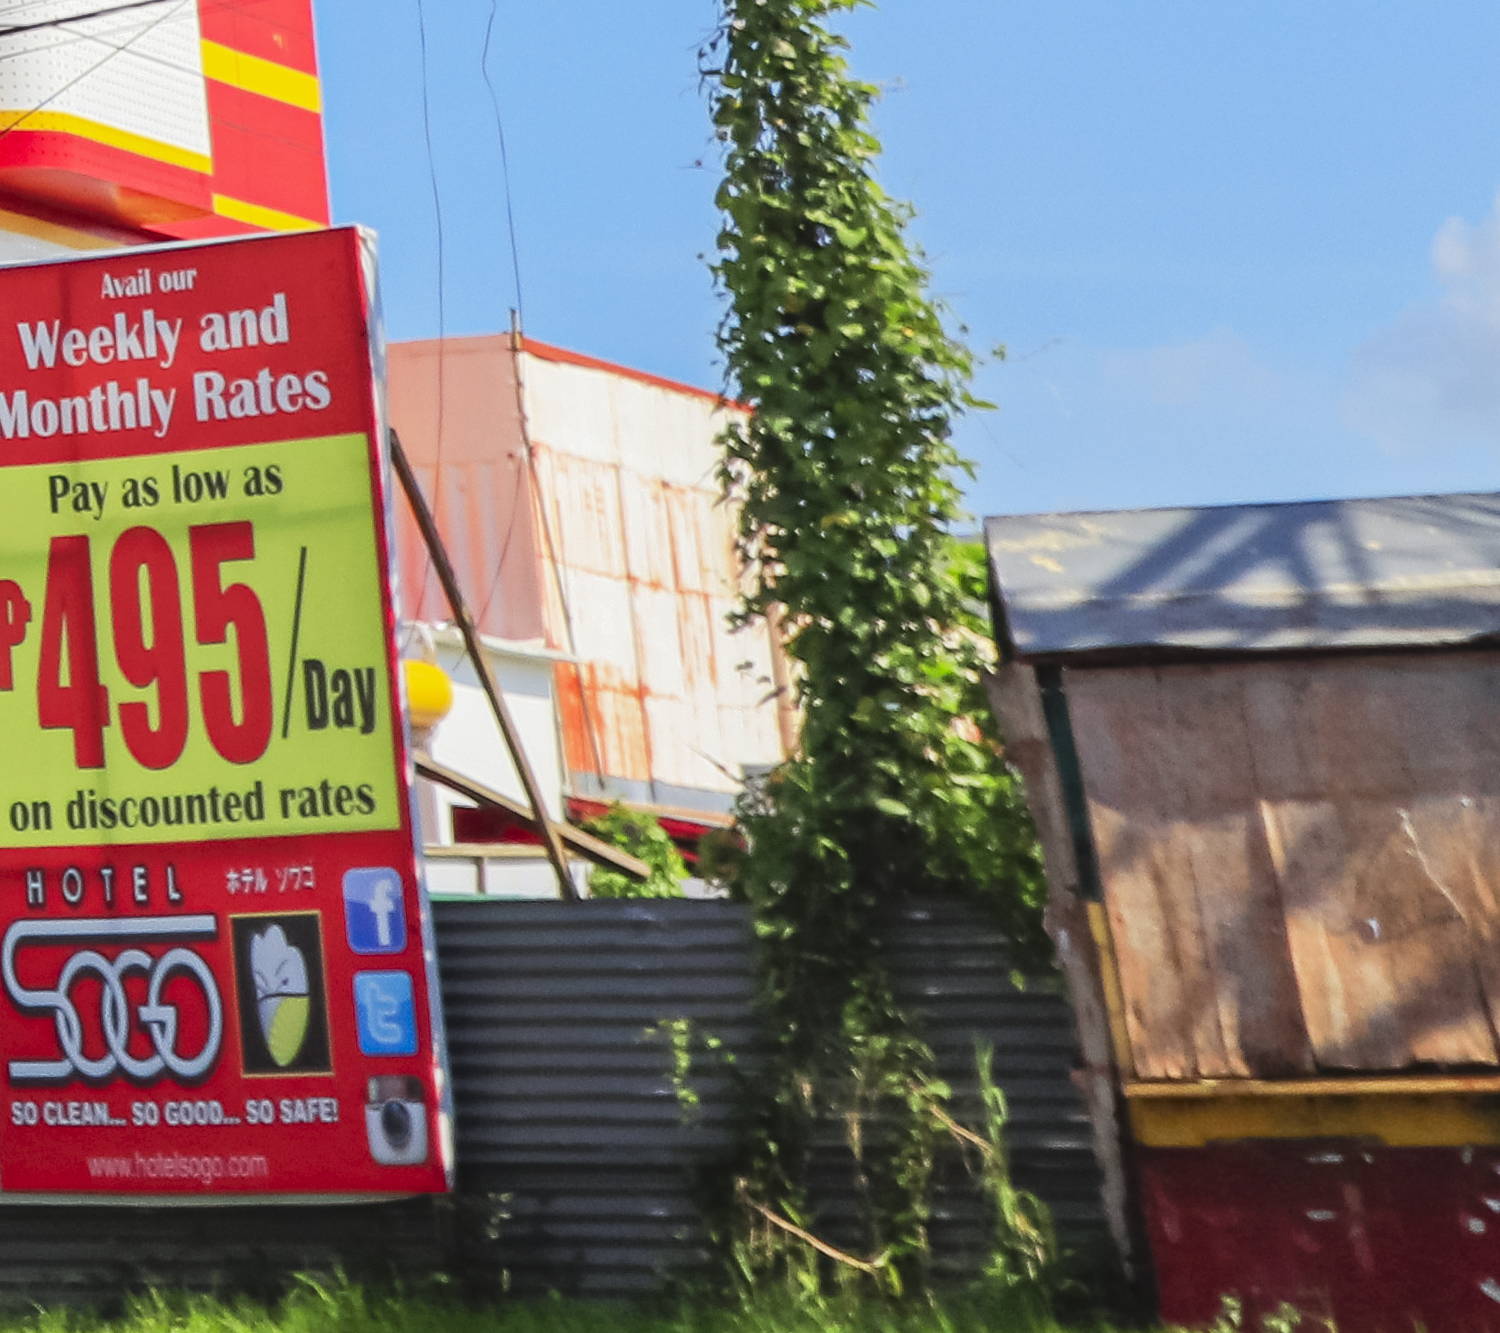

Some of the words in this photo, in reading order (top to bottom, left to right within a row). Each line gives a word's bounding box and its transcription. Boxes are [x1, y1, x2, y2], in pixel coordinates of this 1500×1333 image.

[100, 271, 151, 300] Avail
[159, 267, 198, 293] our
[18, 309, 182, 370] Weekly
[199, 292, 290, 353] and
[192, 369, 332, 423] Rates
[48, 474, 105, 521] Pay
[121, 476, 160, 508] as
[173, 464, 230, 505] low
[243, 464, 283, 496] as
[9, 799, 52, 832] on
[66, 779, 265, 831] discounted
[280, 780, 376, 820] rates
[26, 866, 184, 904] HOTEL
[2, 913, 223, 1080] SOGO
[11, 1101, 38, 1125] SO
[43, 1101, 127, 1126] CLEAN...
[131, 1100, 158, 1125] SO
[164, 1099, 240, 1125] GOOD...
[246, 1098, 274, 1124] SO
[280, 1096, 339, 1123] SAFE!
[87, 1151, 269, 1185] www.hotelsogo.com
